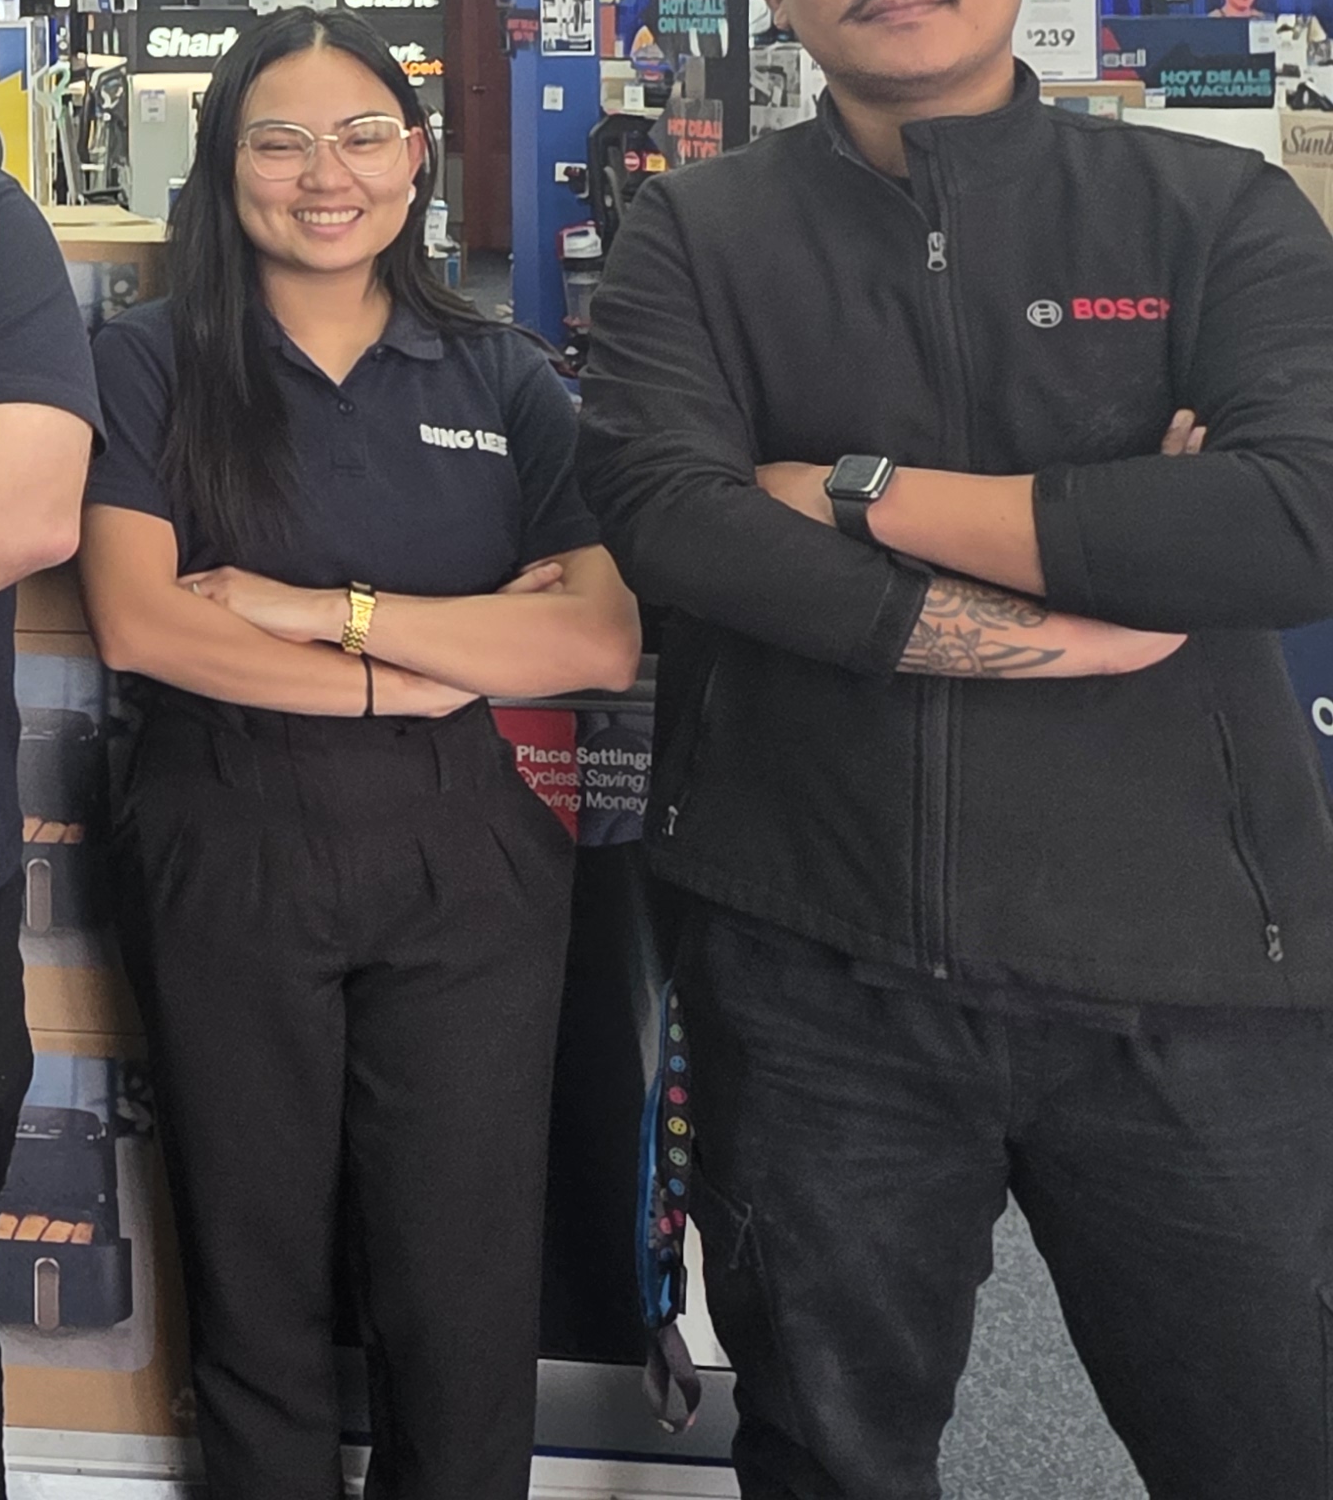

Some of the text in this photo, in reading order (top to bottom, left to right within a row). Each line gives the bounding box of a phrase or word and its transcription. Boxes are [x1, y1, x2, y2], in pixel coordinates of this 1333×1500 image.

[1027, 28, 1076, 47] $239
[1161, 69, 1271, 85] HOT DEALS
[1163, 84, 1272, 98] ON VACUUMS
[420, 424, 508, 456] BING LEE
[516, 745, 572, 764] Place
[585, 769, 646, 793] Saving
[537, 790, 648, 816] ving Money
